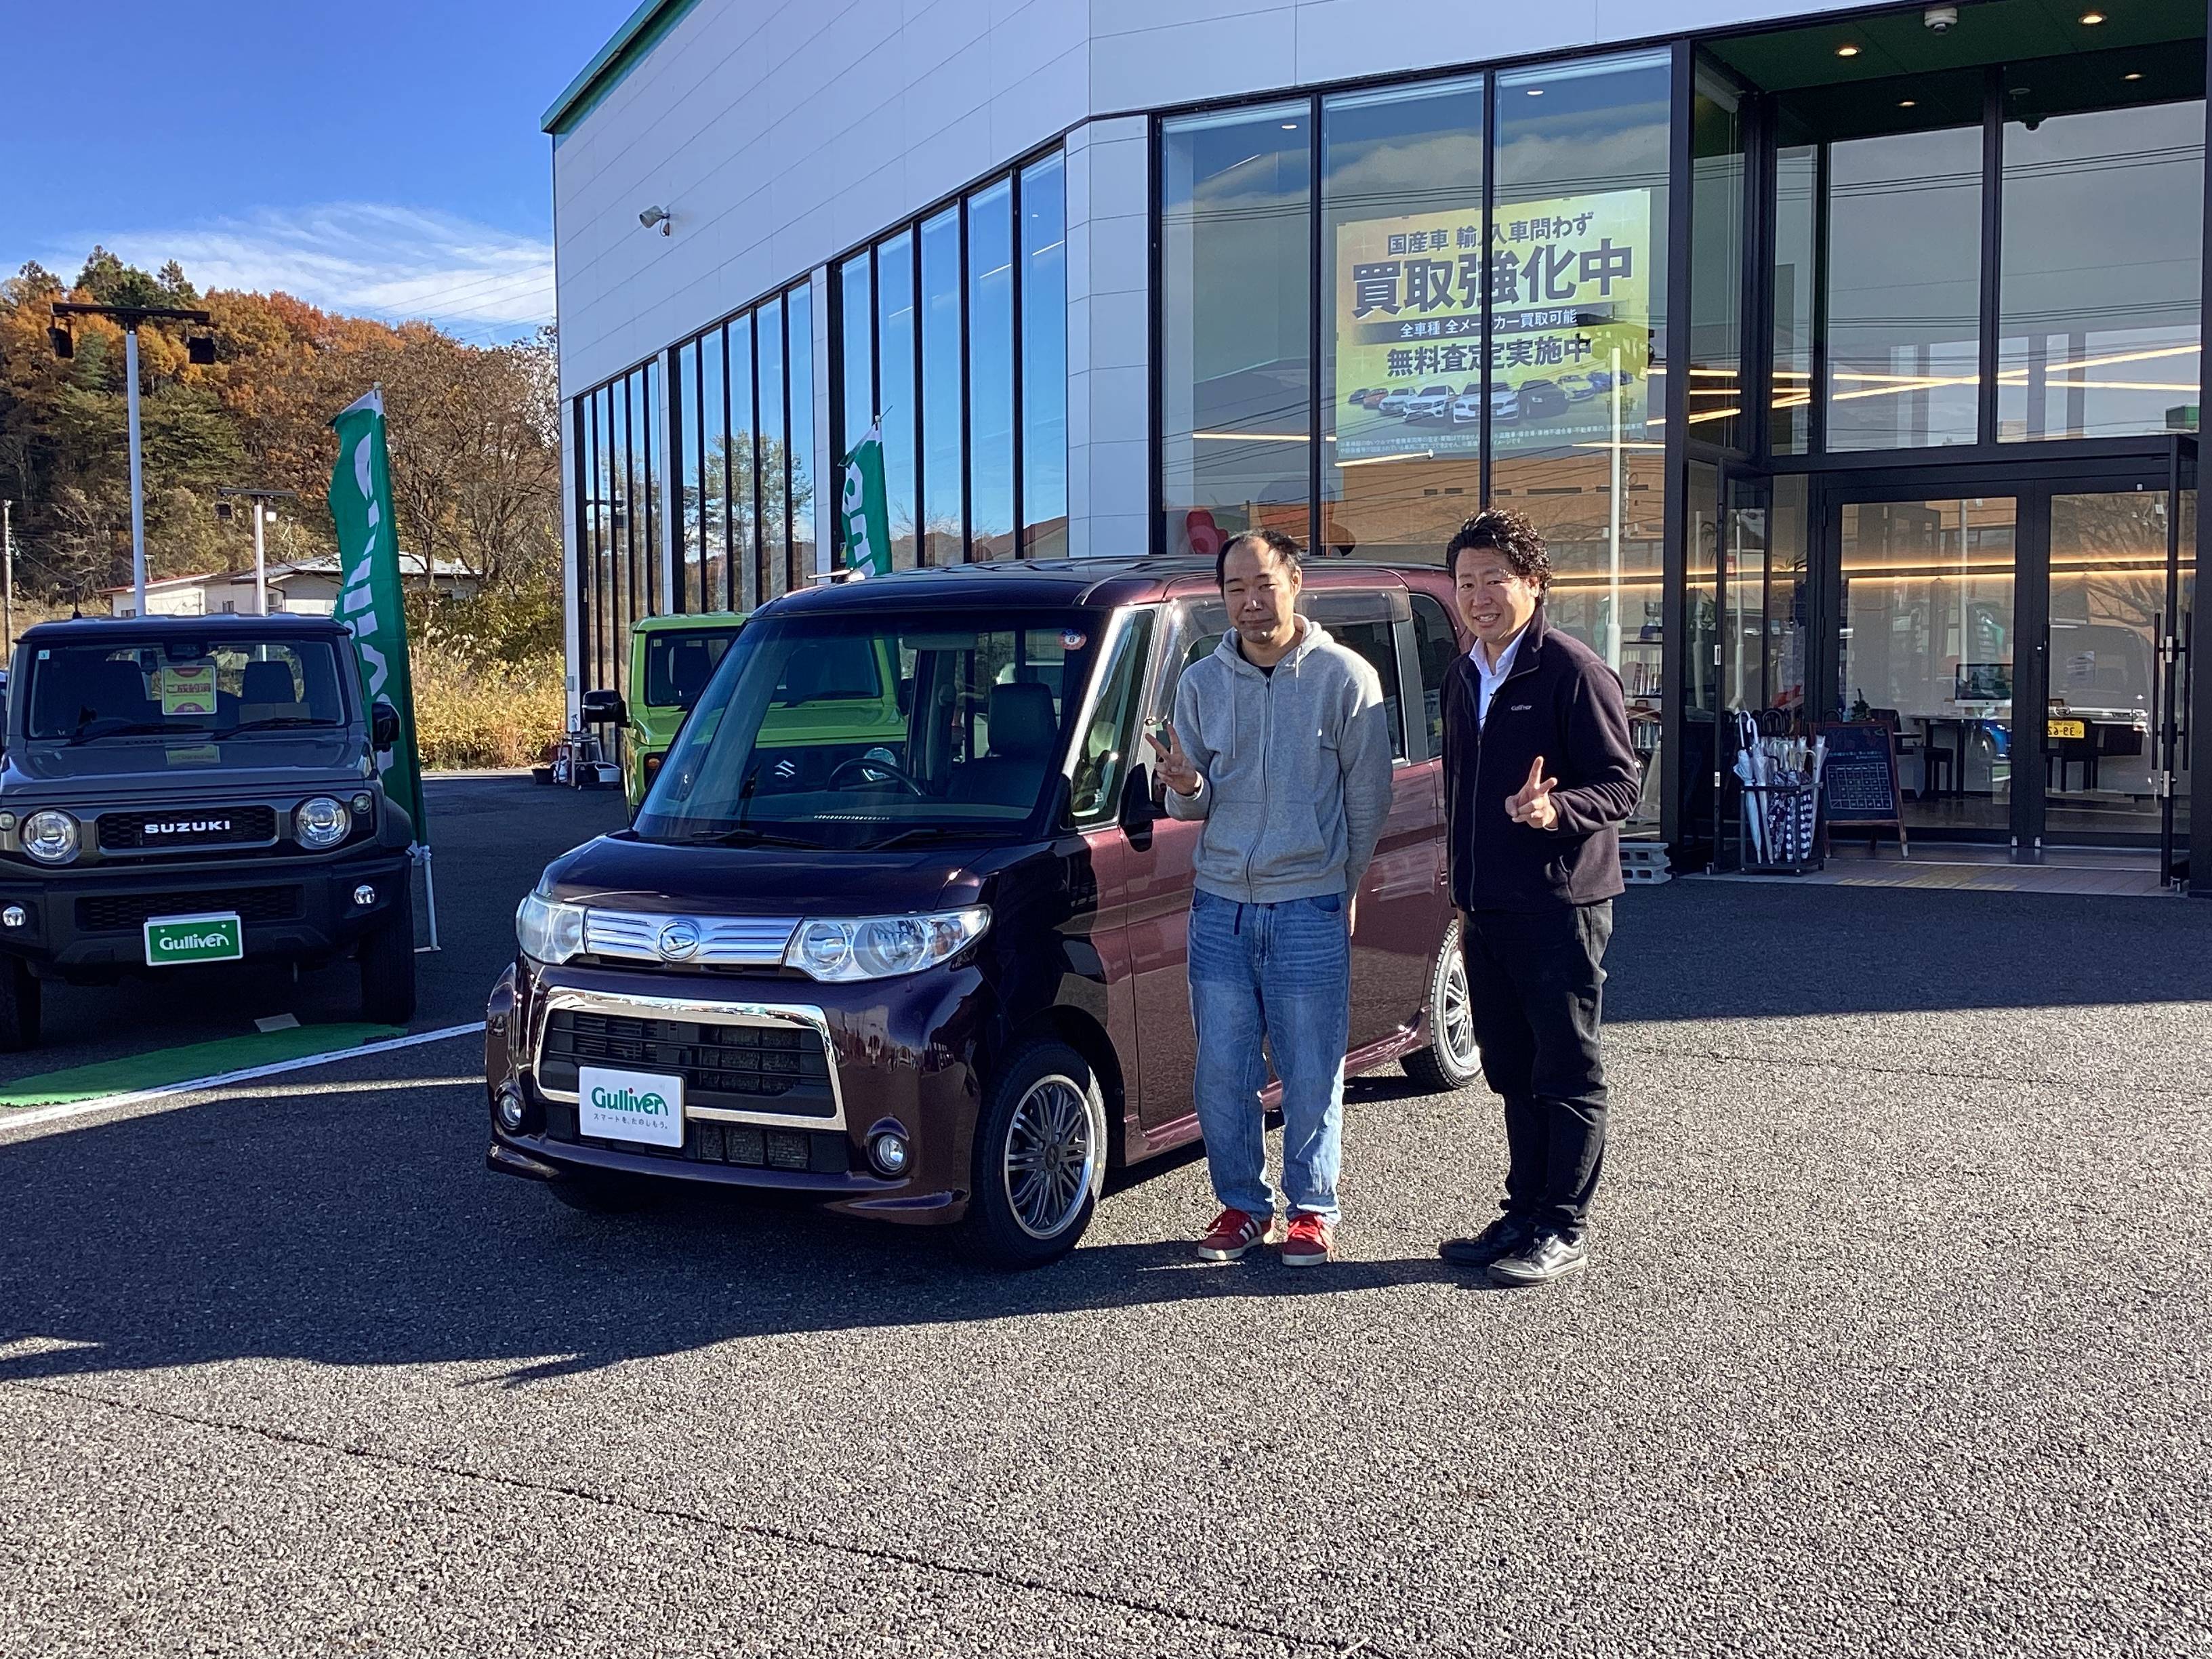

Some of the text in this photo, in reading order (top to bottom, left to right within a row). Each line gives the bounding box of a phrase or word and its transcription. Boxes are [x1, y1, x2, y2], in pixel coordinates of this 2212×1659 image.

[1387, 228, 1449, 256] 国産車
[1353, 238, 1633, 319] 買取強化中
[1400, 308, 1578, 338] 全車種 全メーカー買取可能
[1387, 333, 1592, 377] 無料査定実施中
[144, 820, 230, 834] SUZUKI
[159, 933, 230, 951] Gulliver
[591, 1086, 669, 1117] Gulliver
[594, 1113, 668, 1129] スマートを、たのしもう。
